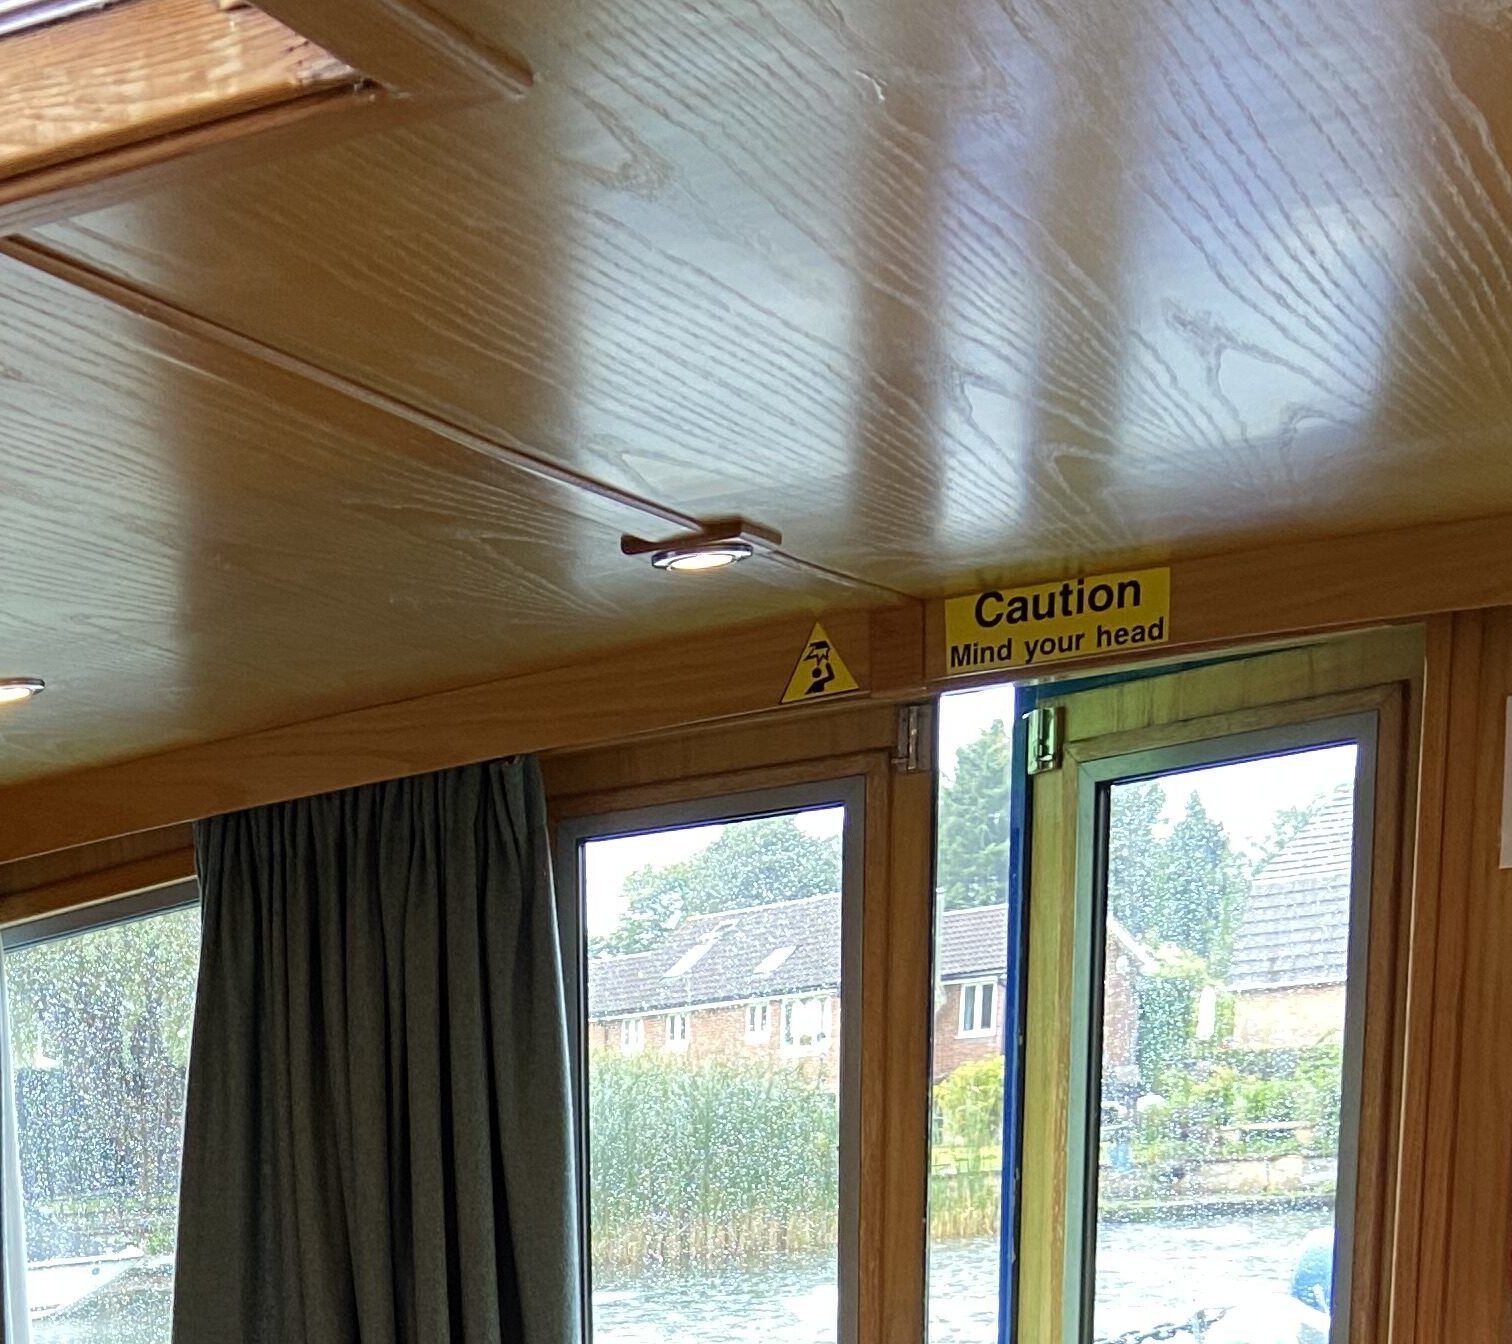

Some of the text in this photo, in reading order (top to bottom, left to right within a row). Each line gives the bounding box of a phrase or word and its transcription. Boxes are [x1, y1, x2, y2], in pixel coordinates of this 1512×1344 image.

[974, 578, 1142, 629] Caution
[950, 615, 1165, 669] Mind your head
